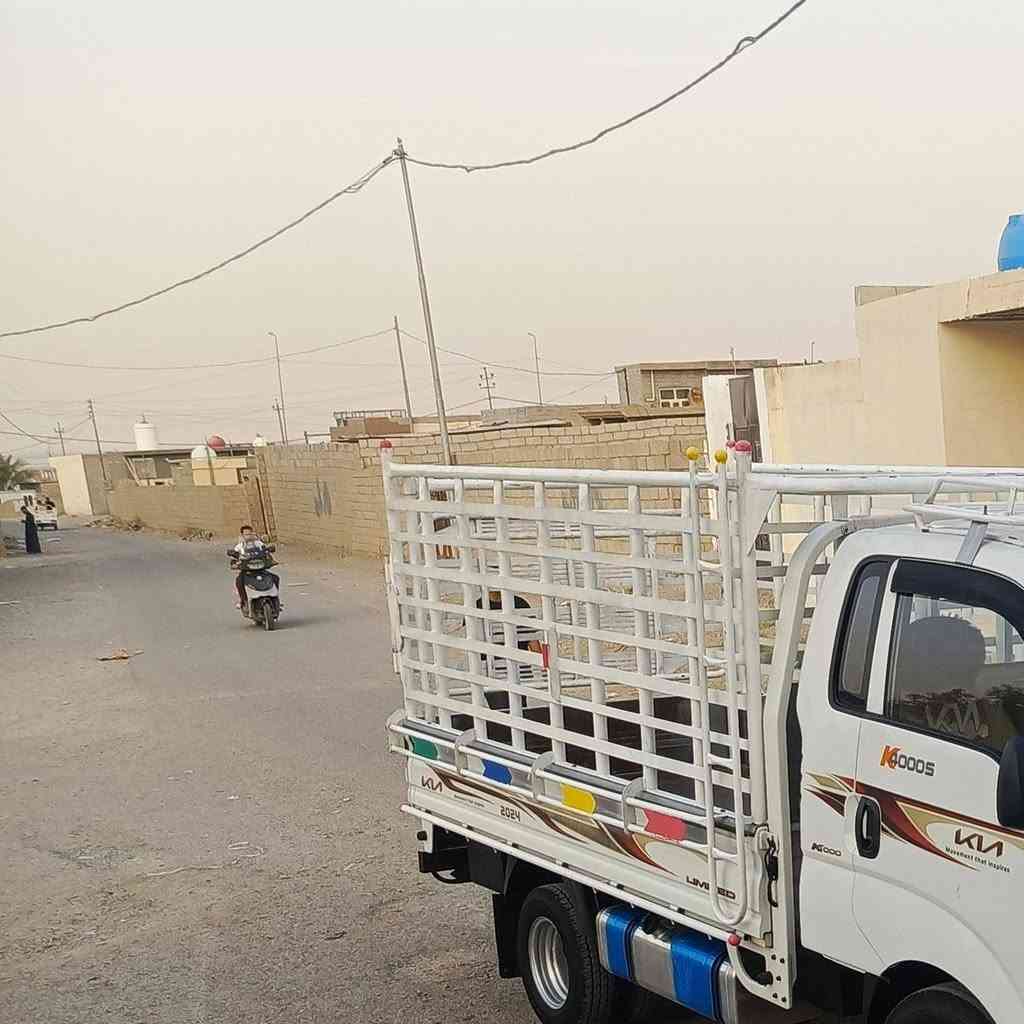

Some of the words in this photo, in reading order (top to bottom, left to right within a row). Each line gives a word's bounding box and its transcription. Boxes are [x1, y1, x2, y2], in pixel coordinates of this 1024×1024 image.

[880, 745, 935, 776] K4000S
[421, 775, 443, 792] KIA
[500, 805, 521, 822] 2024
[954, 828, 1004, 857] KIA
